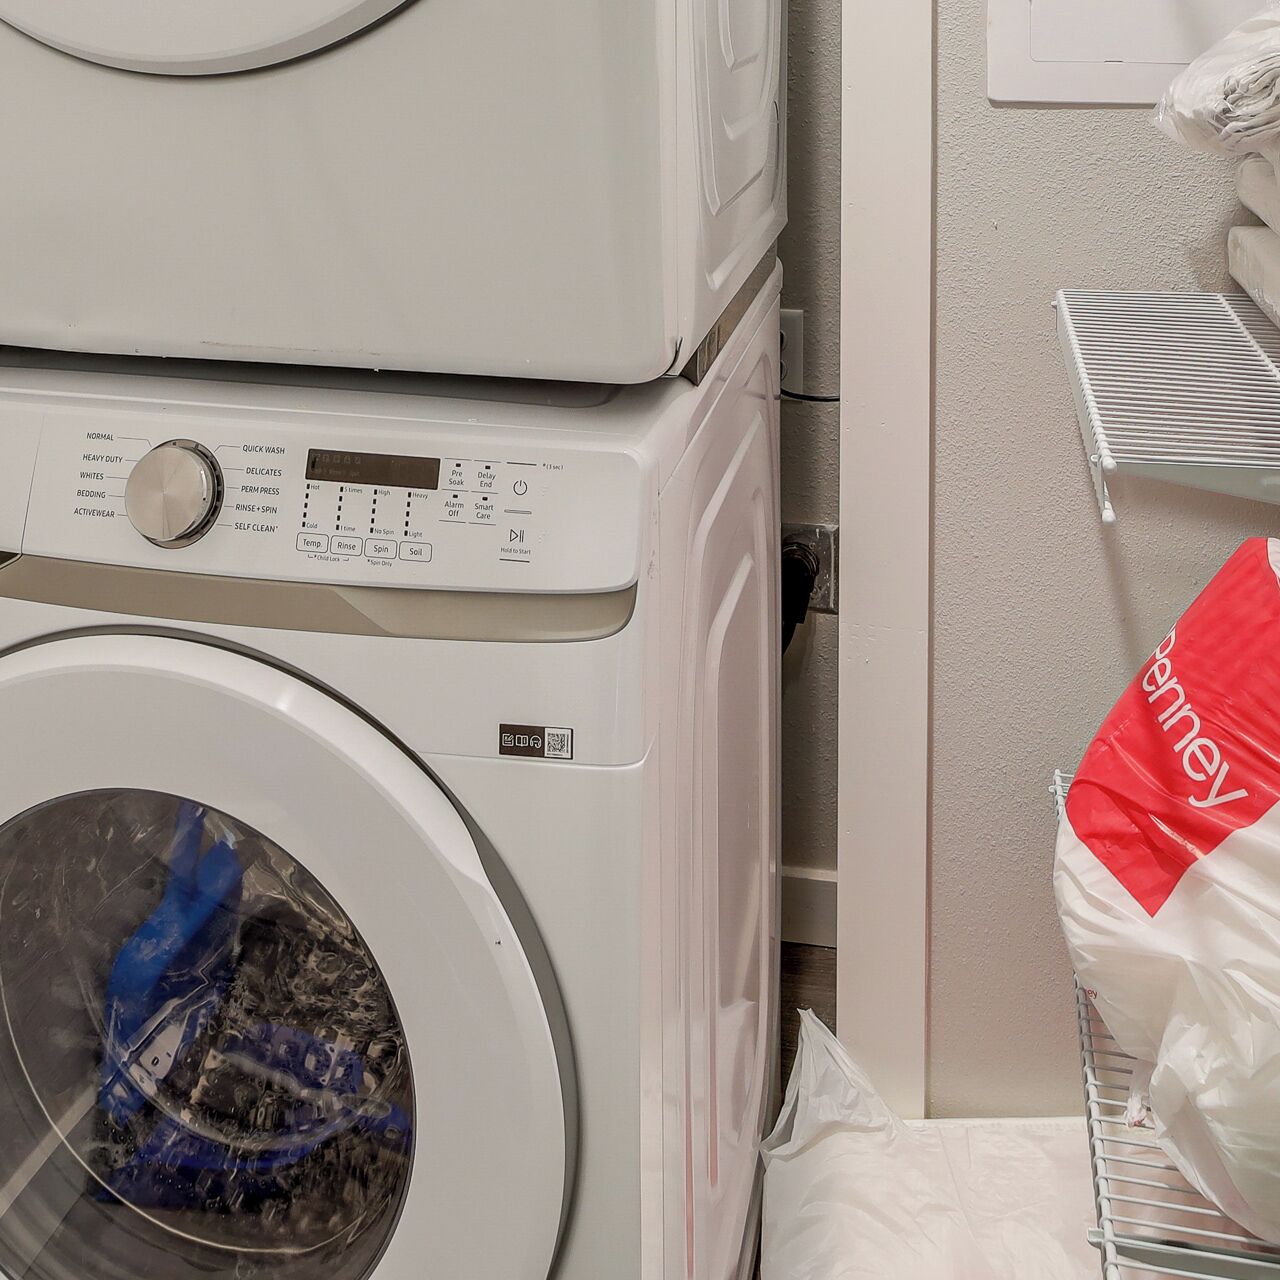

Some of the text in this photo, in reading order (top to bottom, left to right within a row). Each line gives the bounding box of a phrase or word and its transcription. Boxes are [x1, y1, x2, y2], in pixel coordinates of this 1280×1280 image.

[86, 432, 114, 441] NORMAL
[242, 444, 285, 455] QUICK WASH
[82, 453, 123, 463] HEAVY DUTY
[79, 471, 104, 480] WHITES
[245, 467, 282, 477] DELICATES
[451, 469, 463, 477] Pre
[477, 471, 496, 480] Delay
[448, 478, 464, 486] Soak
[479, 480, 492, 488] End
[76, 489, 106, 499] BEDDING
[241, 485, 280, 496] PERM PRESS
[235, 504, 256, 512] RINSE
[261, 506, 278, 514] SPIN
[444, 500, 465, 509] Alarm
[474, 502, 494, 511] Smart
[73, 507, 115, 518] ACTIVEWEAR
[448, 509, 459, 517] Off
[476, 511, 491, 519] Care
[234, 522, 251, 531] SELF
[383, 528, 395, 536] Spin
[303, 539, 323, 548] Temp.
[337, 542, 357, 551] Rinse
[373, 545, 389, 554] Spin
[409, 547, 423, 556] Soil
